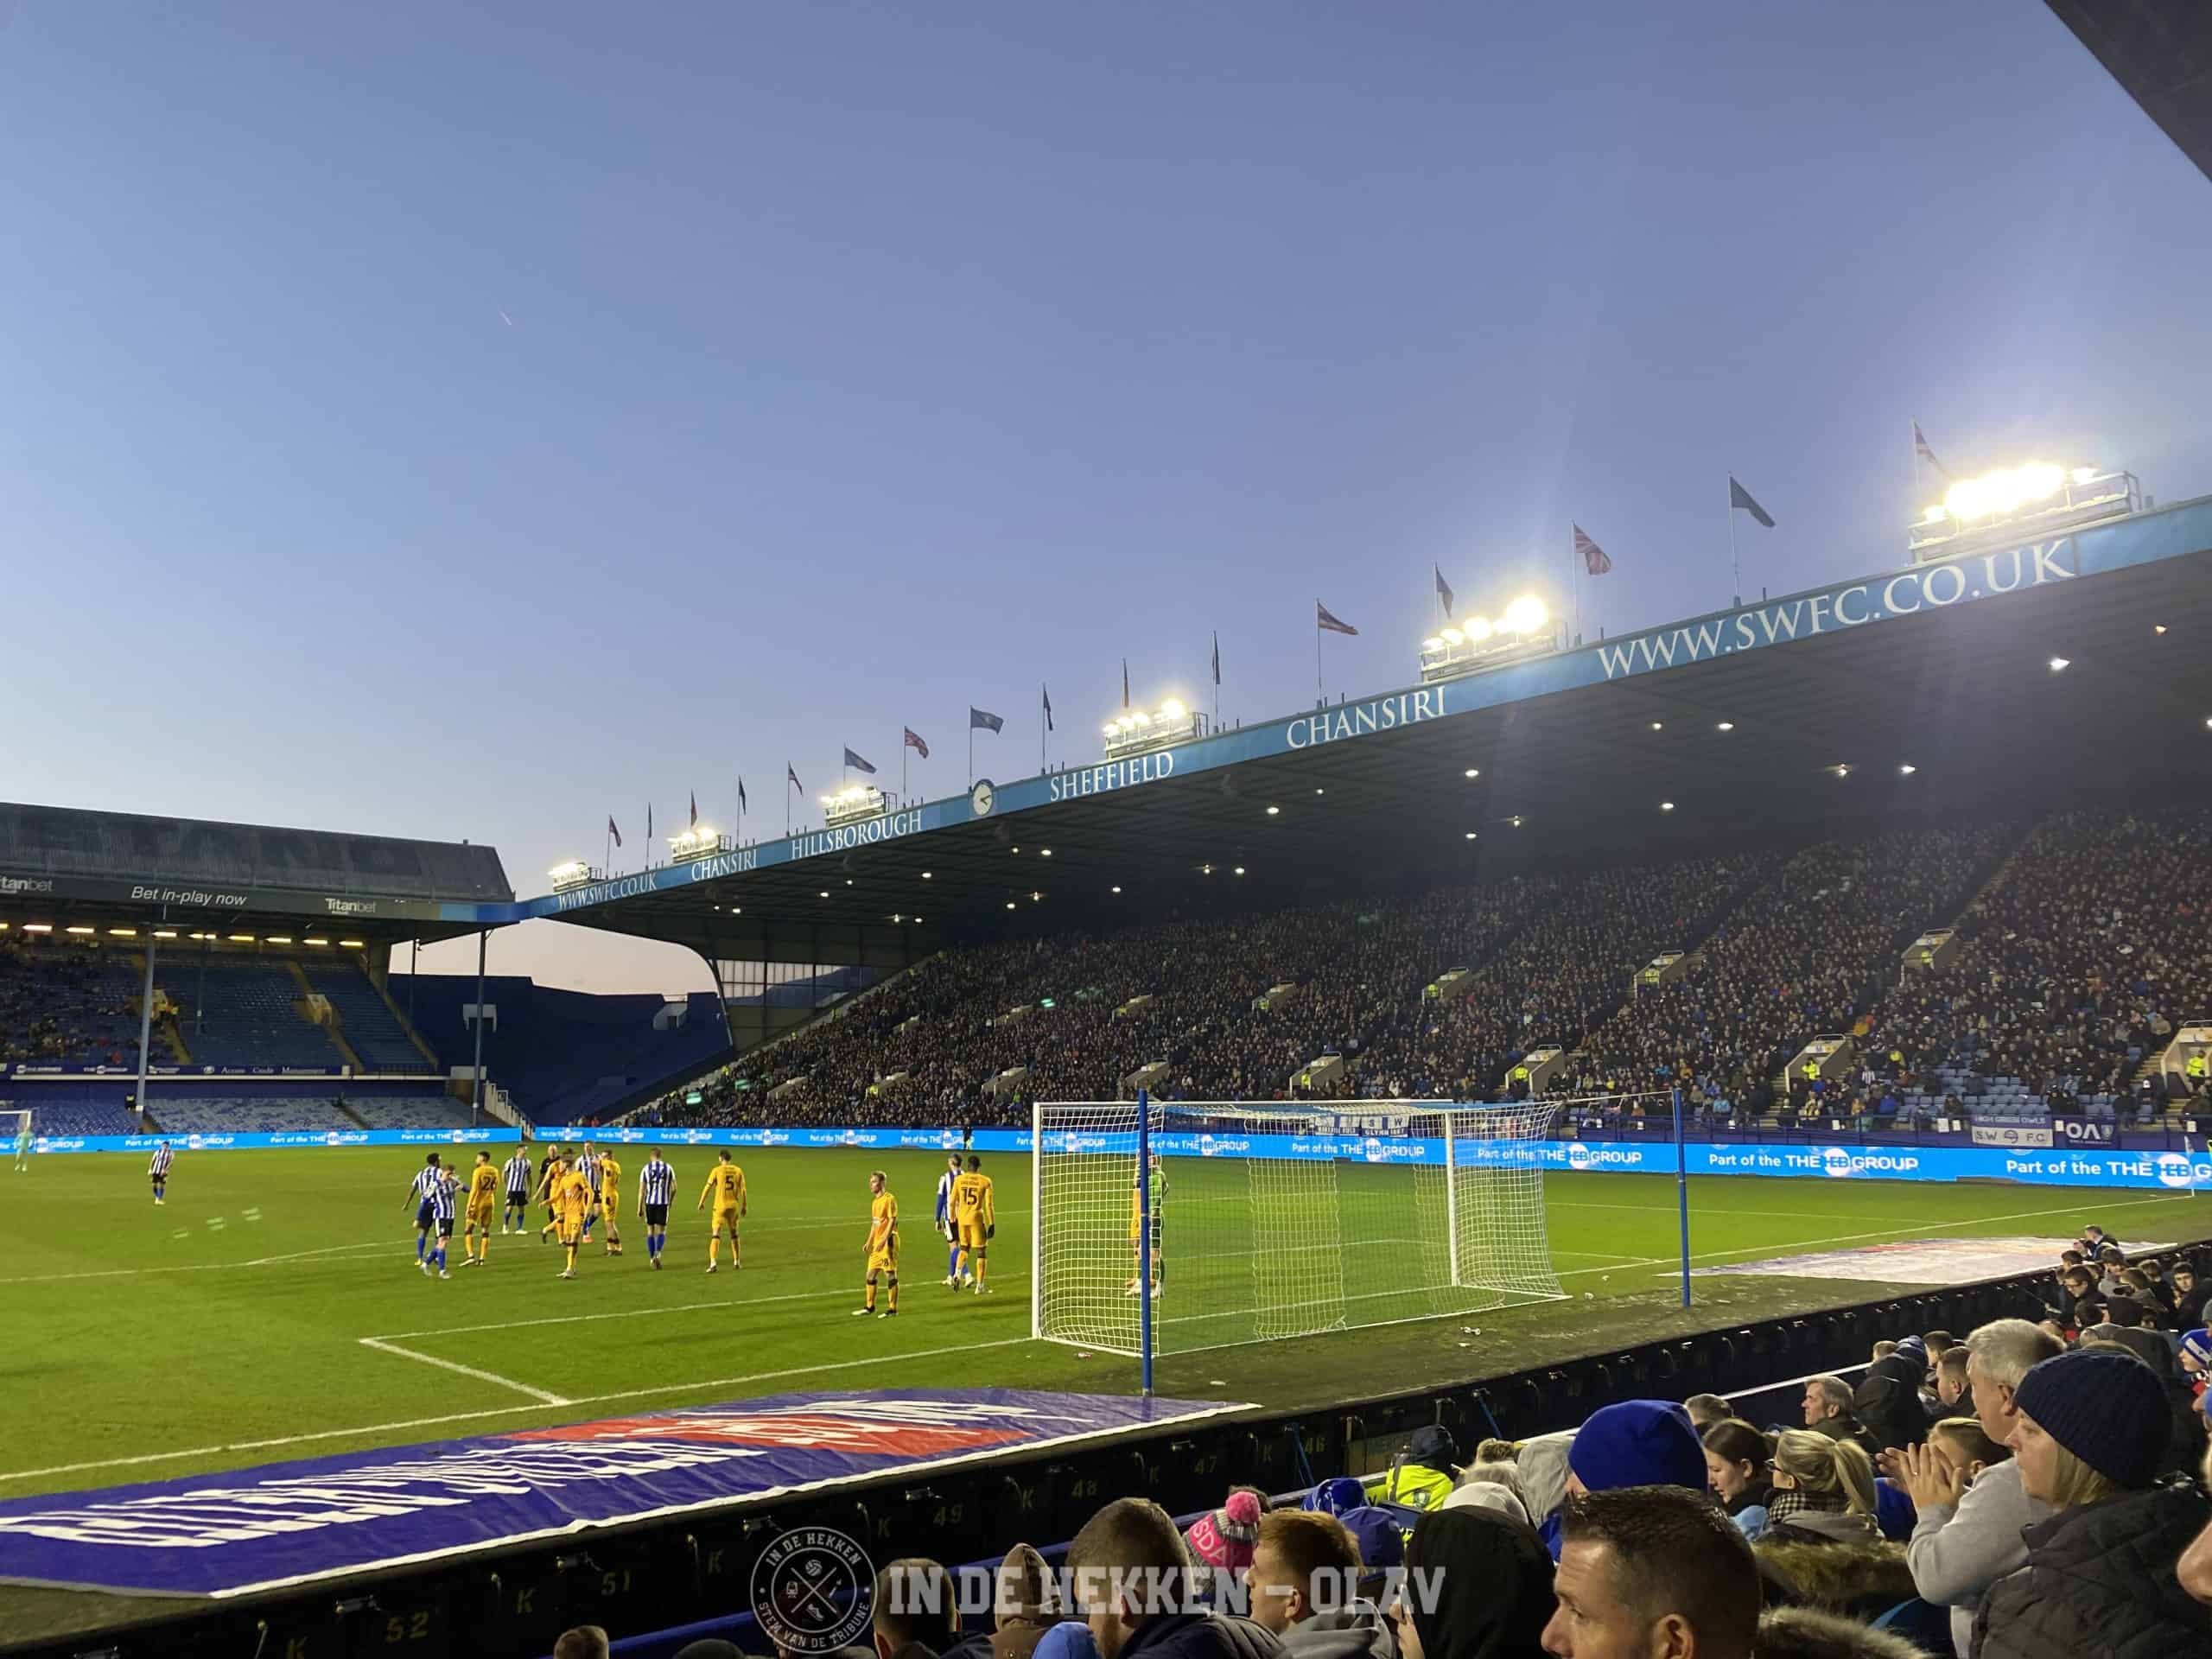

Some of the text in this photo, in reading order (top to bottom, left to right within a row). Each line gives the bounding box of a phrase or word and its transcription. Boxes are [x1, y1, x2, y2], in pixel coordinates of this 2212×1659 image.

[1598, 537, 2075, 679] WWW.SWFC.CO.UK
[1287, 686, 1446, 749] CHANSIRI
[1050, 751, 1173, 802] SHEFFIELD
[791, 810, 923, 860] HILLSBOROUGH
[691, 849, 757, 881] CHANSIRI
[0, 876, 53, 892] tanbet
[131, 886, 247, 906] Bet in-play now
[325, 897, 377, 912] Titanbet
[1182, 1141, 1199, 1150] THE
[1216, 1141, 1249, 1151] GROUP
[1292, 1143, 1309, 1153] Part
[1313, 1143, 1322, 1153] of
[1324, 1144, 1338, 1154] the
[1341, 1144, 1363, 1154] THE
[1382, 1146, 1425, 1156] GROUP
[1503, 1148, 1515, 1159] of
[1516, 1149, 1535, 1160] the
[1538, 1150, 1566, 1161] THE
[1589, 1152, 1643, 1163] GROUP
[1709, 1154, 1736, 1166] Part
[1740, 1154, 1755, 1166] of
[1758, 1154, 1782, 1166] the
[1785, 1154, 1821, 1168] THE
[1852, 1156, 1919, 1170] GROUP
[2005, 1160, 2043, 1173] Part
[2048, 1160, 2067, 1174] of
[2071, 1161, 2101, 1175] the
[2107, 1161, 2154, 1176] THE
[725, 1175, 734, 1191] 5
[961, 1186, 978, 1205] 15
[1193, 1453, 1218, 1474] 47
[1022, 1486, 1037, 1509] K
[932, 1501, 964, 1527] 49
[877, 1516, 892, 1539] K
[707, 1549, 724, 1576] K
[601, 1569, 632, 1596] 51
[515, 1586, 537, 1613] K
[386, 1611, 430, 1644] 52
